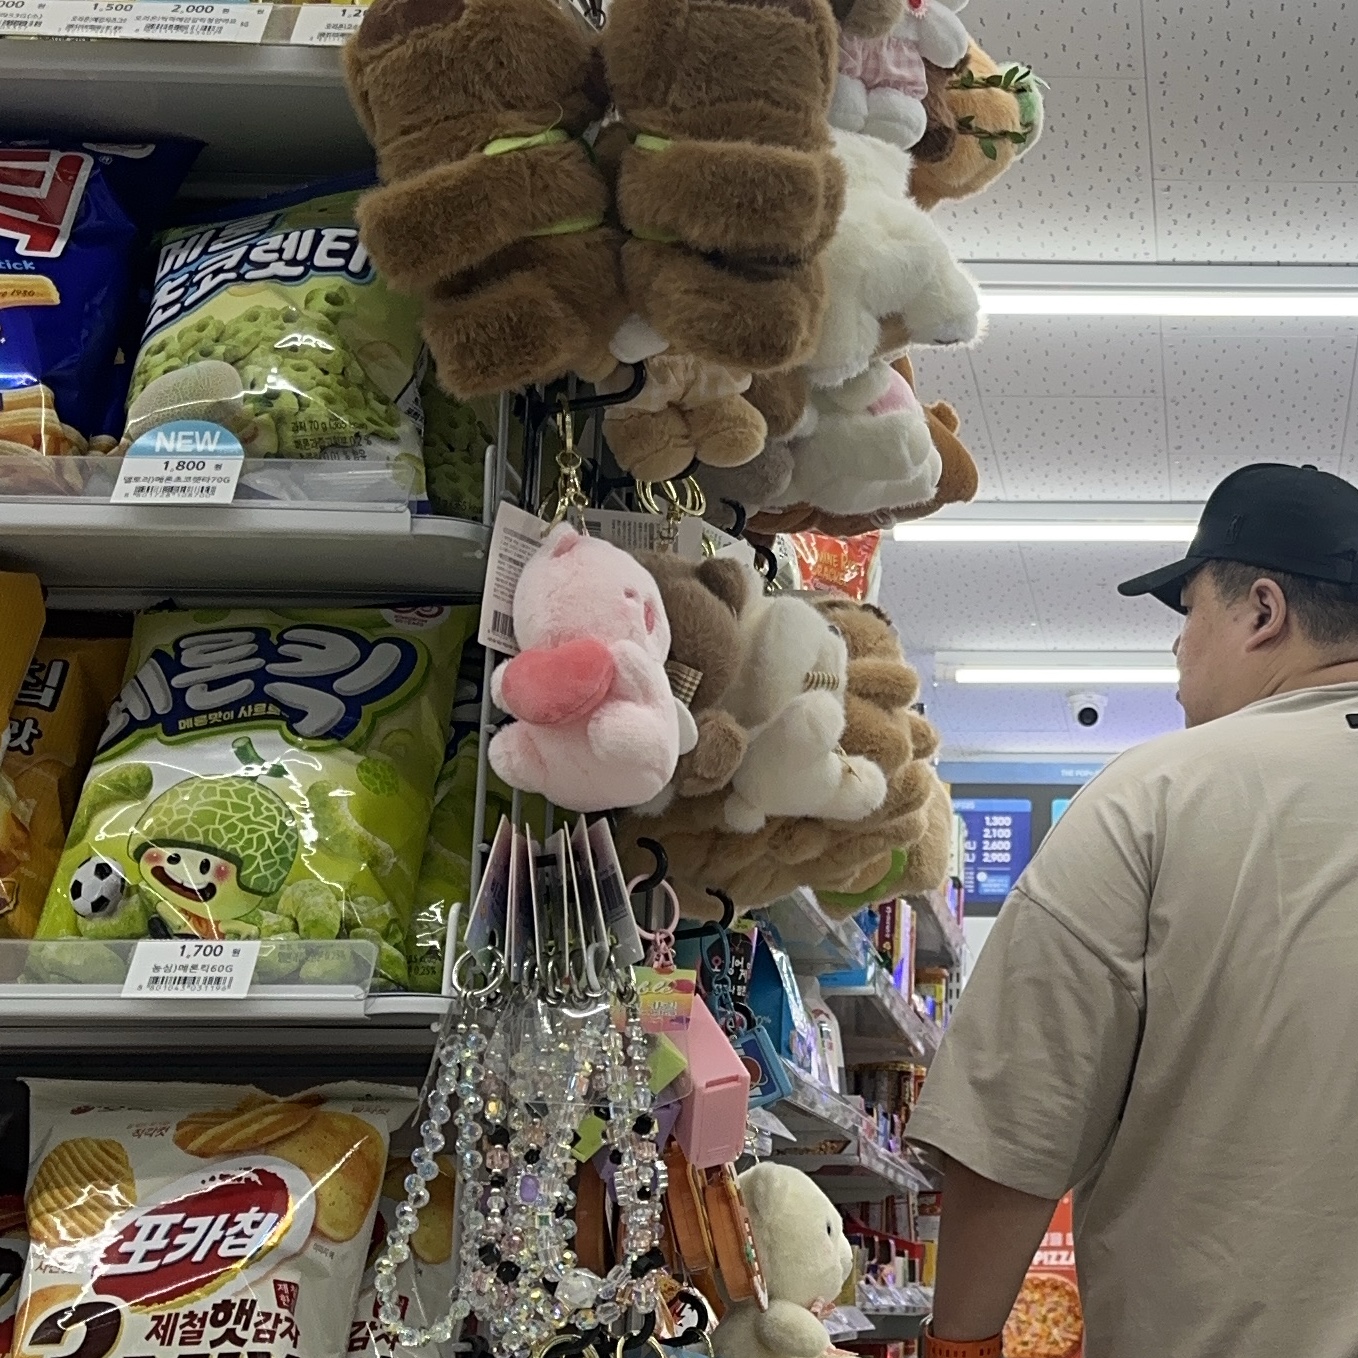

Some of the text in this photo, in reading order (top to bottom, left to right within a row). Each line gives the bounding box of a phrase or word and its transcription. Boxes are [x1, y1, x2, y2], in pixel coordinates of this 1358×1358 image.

[171, 4, 215, 14] 2,000
[155, 431, 220, 453] NEW
[162, 460, 206, 472] 1,800
[179, 944, 223, 959] 1,700
[92, 1206, 281, 1278] 포카칩
